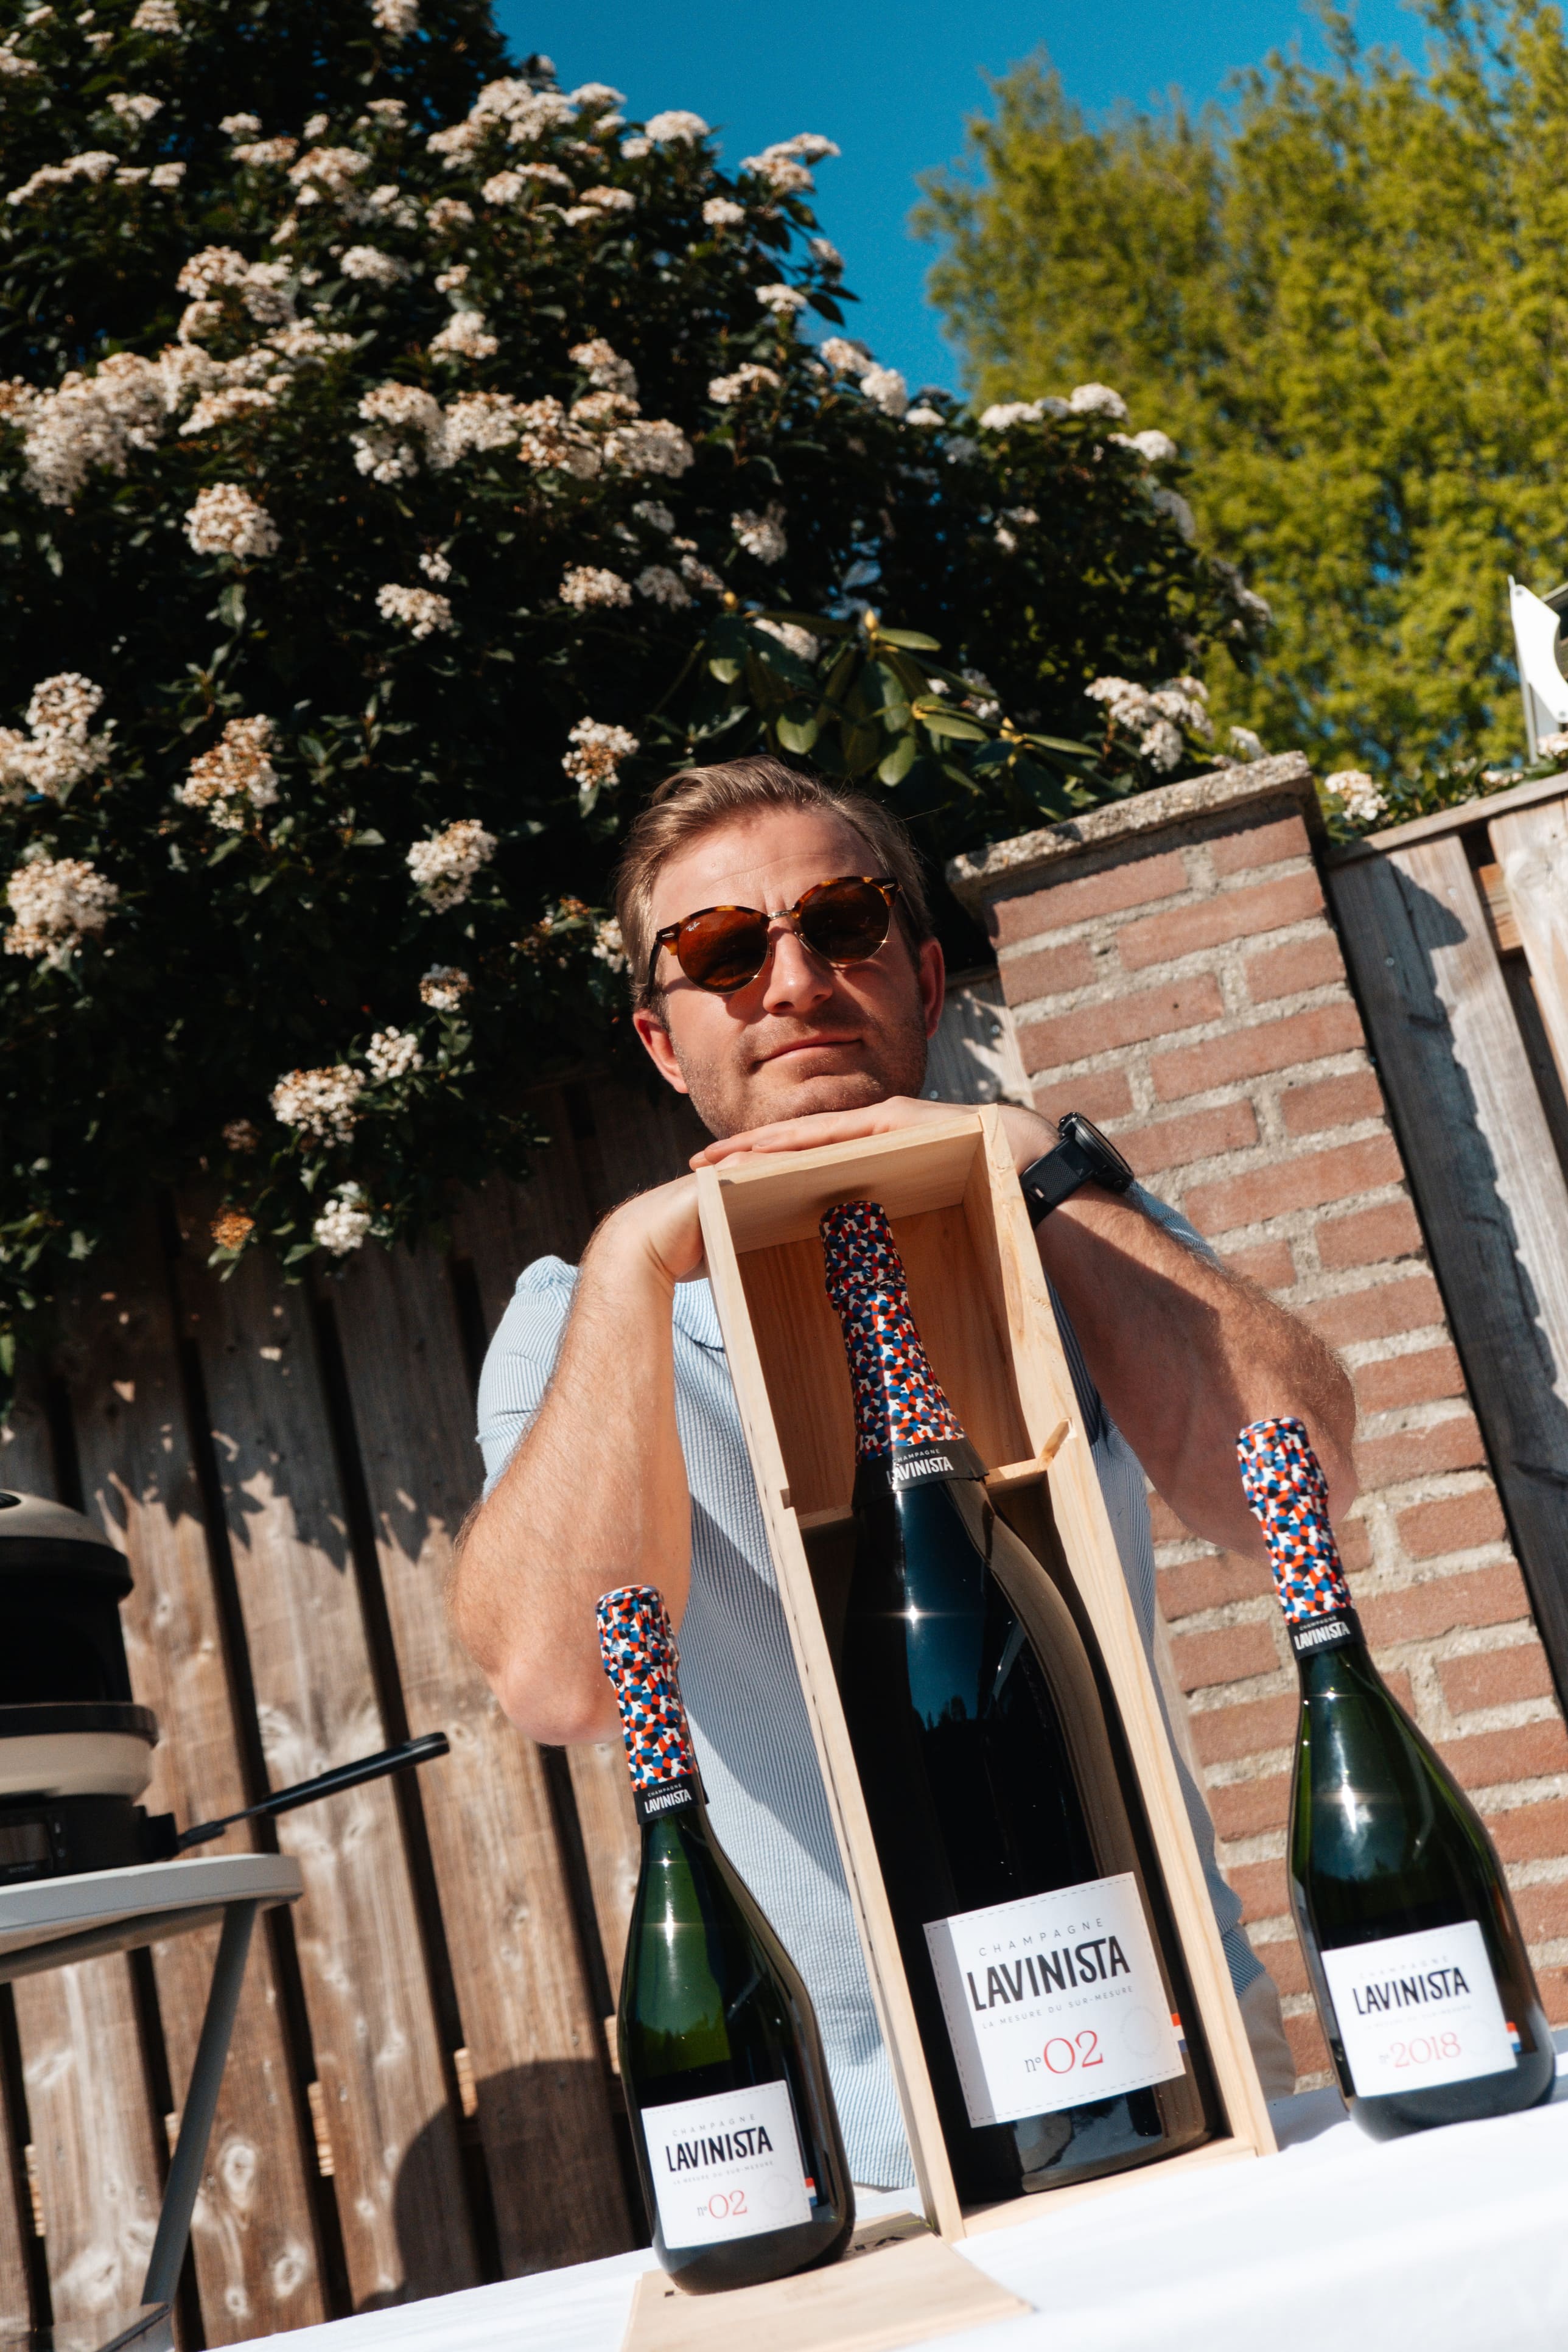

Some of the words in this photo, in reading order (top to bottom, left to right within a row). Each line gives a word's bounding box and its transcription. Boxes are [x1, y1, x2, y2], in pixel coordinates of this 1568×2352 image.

[892, 1449, 940, 1462] CHAMPAGNE
[886, 1456, 954, 1485] LAVINISTA
[1293, 1621, 1351, 1650] LAVINISTA
[644, 1789, 692, 1814] LAVINISTA
[648, 1783, 682, 1797] CHAMPAGNE
[979, 1918, 1104, 1957] CHAMPAGNE
[967, 1936, 1130, 2011] LAVINISTA
[1352, 1967, 1471, 2015] LAVINISTA
[982, 2020, 994, 2029] LA
[999, 2009, 1042, 2025] MESURE
[1048, 2004, 1062, 2014] DU
[1068, 1985, 1133, 2009] SUR-MESURE
[673, 2113, 756, 2137] CHAMPAGNE
[665, 2126, 774, 2172] LAVINISTA
